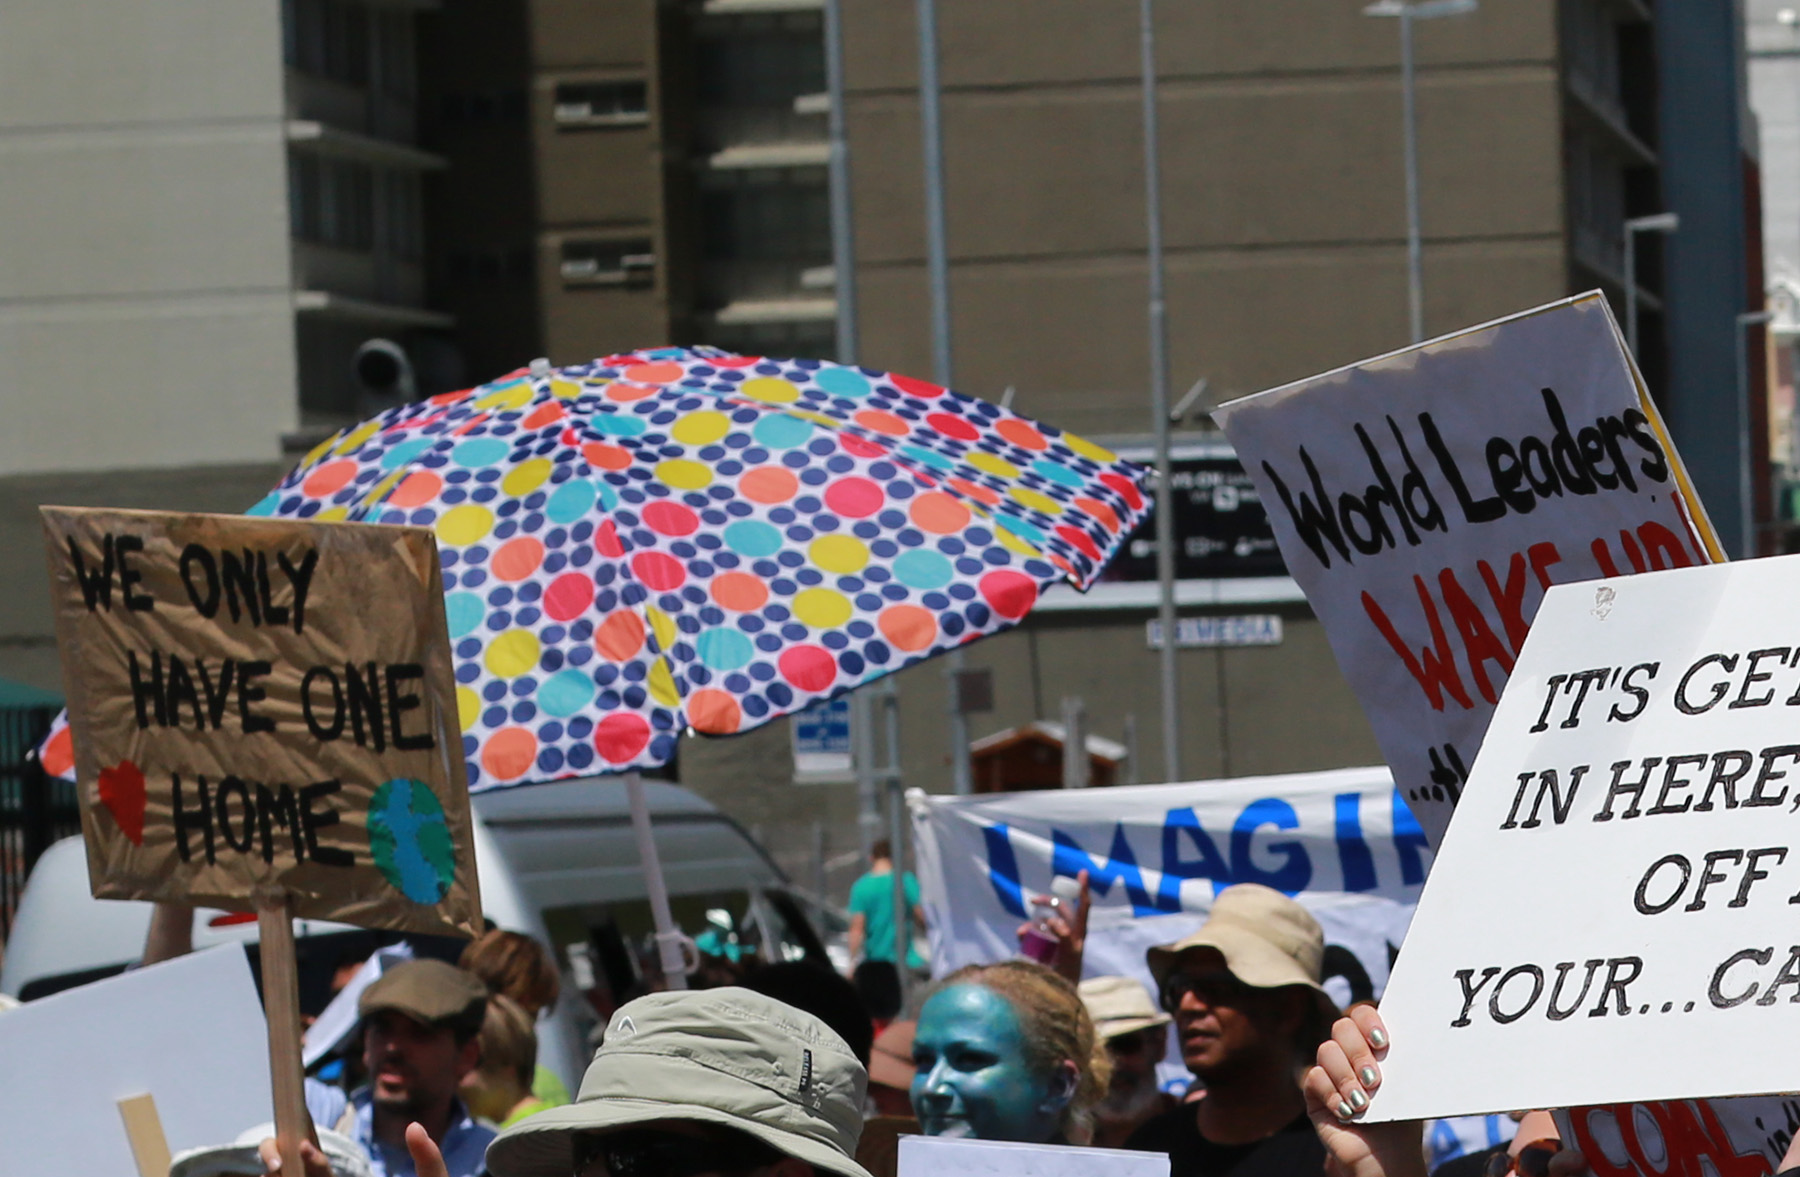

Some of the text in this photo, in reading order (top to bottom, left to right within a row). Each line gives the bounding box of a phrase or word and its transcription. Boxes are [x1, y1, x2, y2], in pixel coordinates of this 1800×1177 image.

[1262, 413, 1448, 570] World
[1418, 387, 1668, 523] Leaders
[67, 532, 319, 634] WE ONLY
[128, 649, 434, 754] HAVE ONE
[1530, 661, 1661, 733] IT'S
[172, 771, 355, 867] HOME
[1499, 766, 1588, 830] IN
[1633, 846, 1787, 915] OFF
